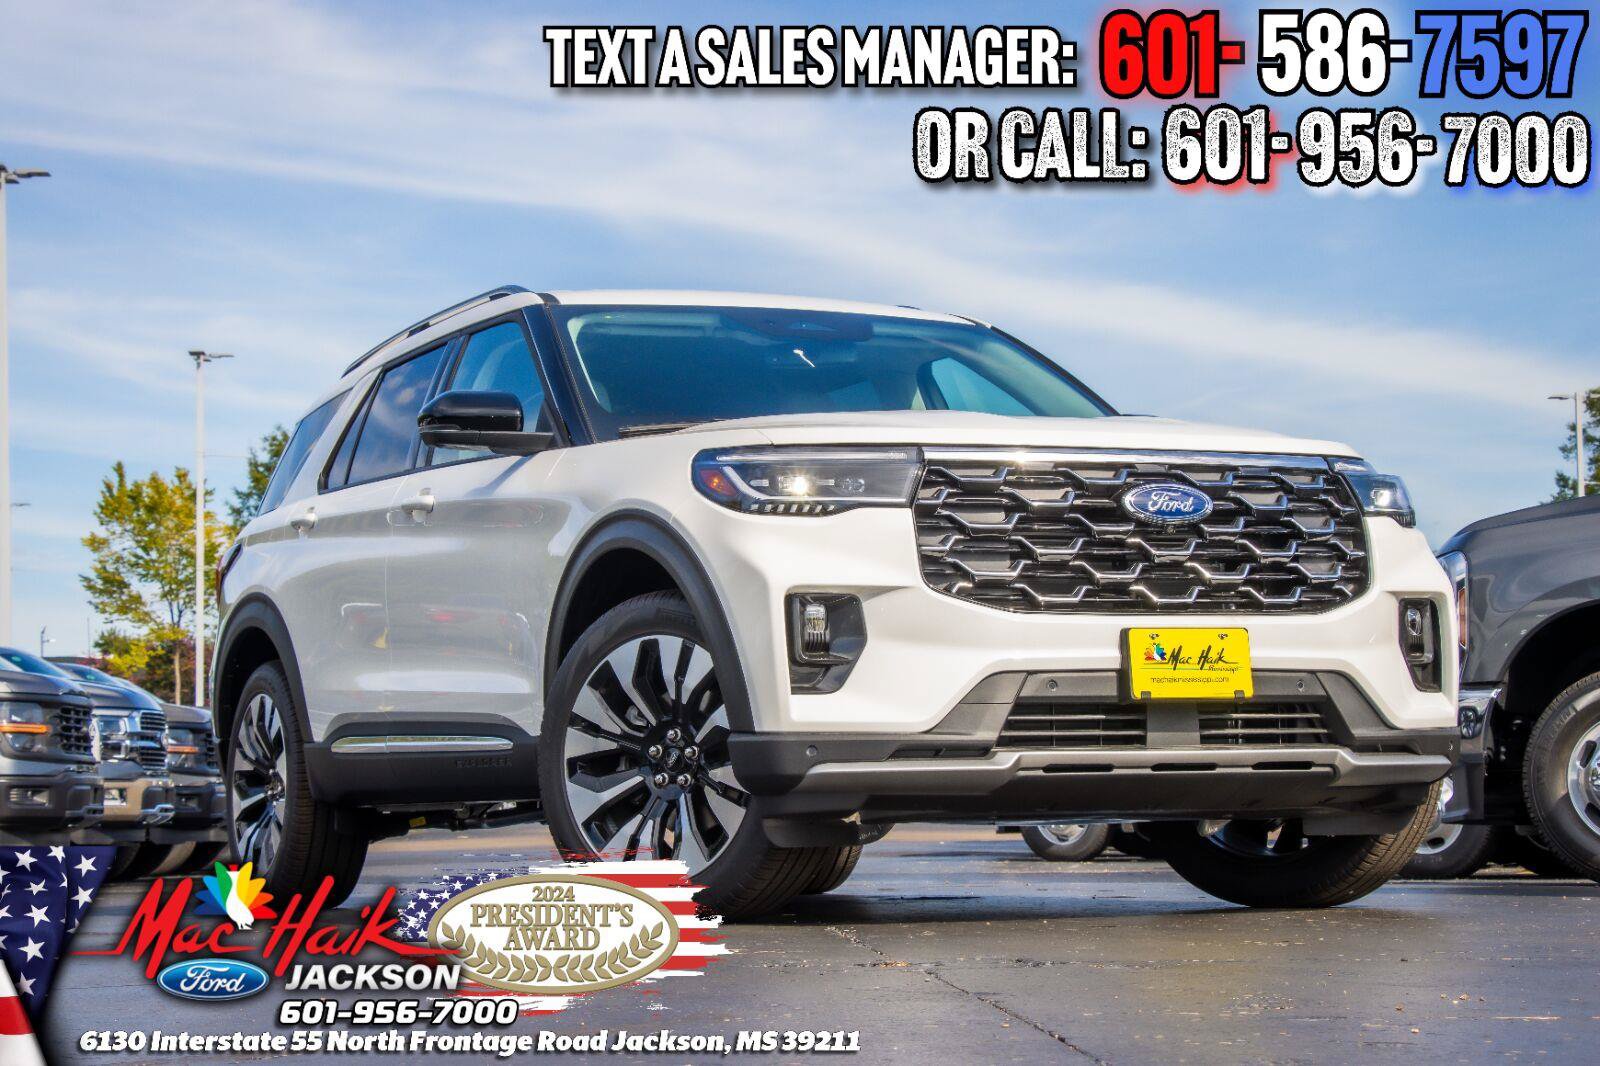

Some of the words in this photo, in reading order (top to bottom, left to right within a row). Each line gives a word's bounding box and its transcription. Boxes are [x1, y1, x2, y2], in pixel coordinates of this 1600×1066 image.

[1148, 491, 1194, 512] Ford
[1167, 645, 1192, 670] Mac
[1197, 645, 1233, 670] Haik
